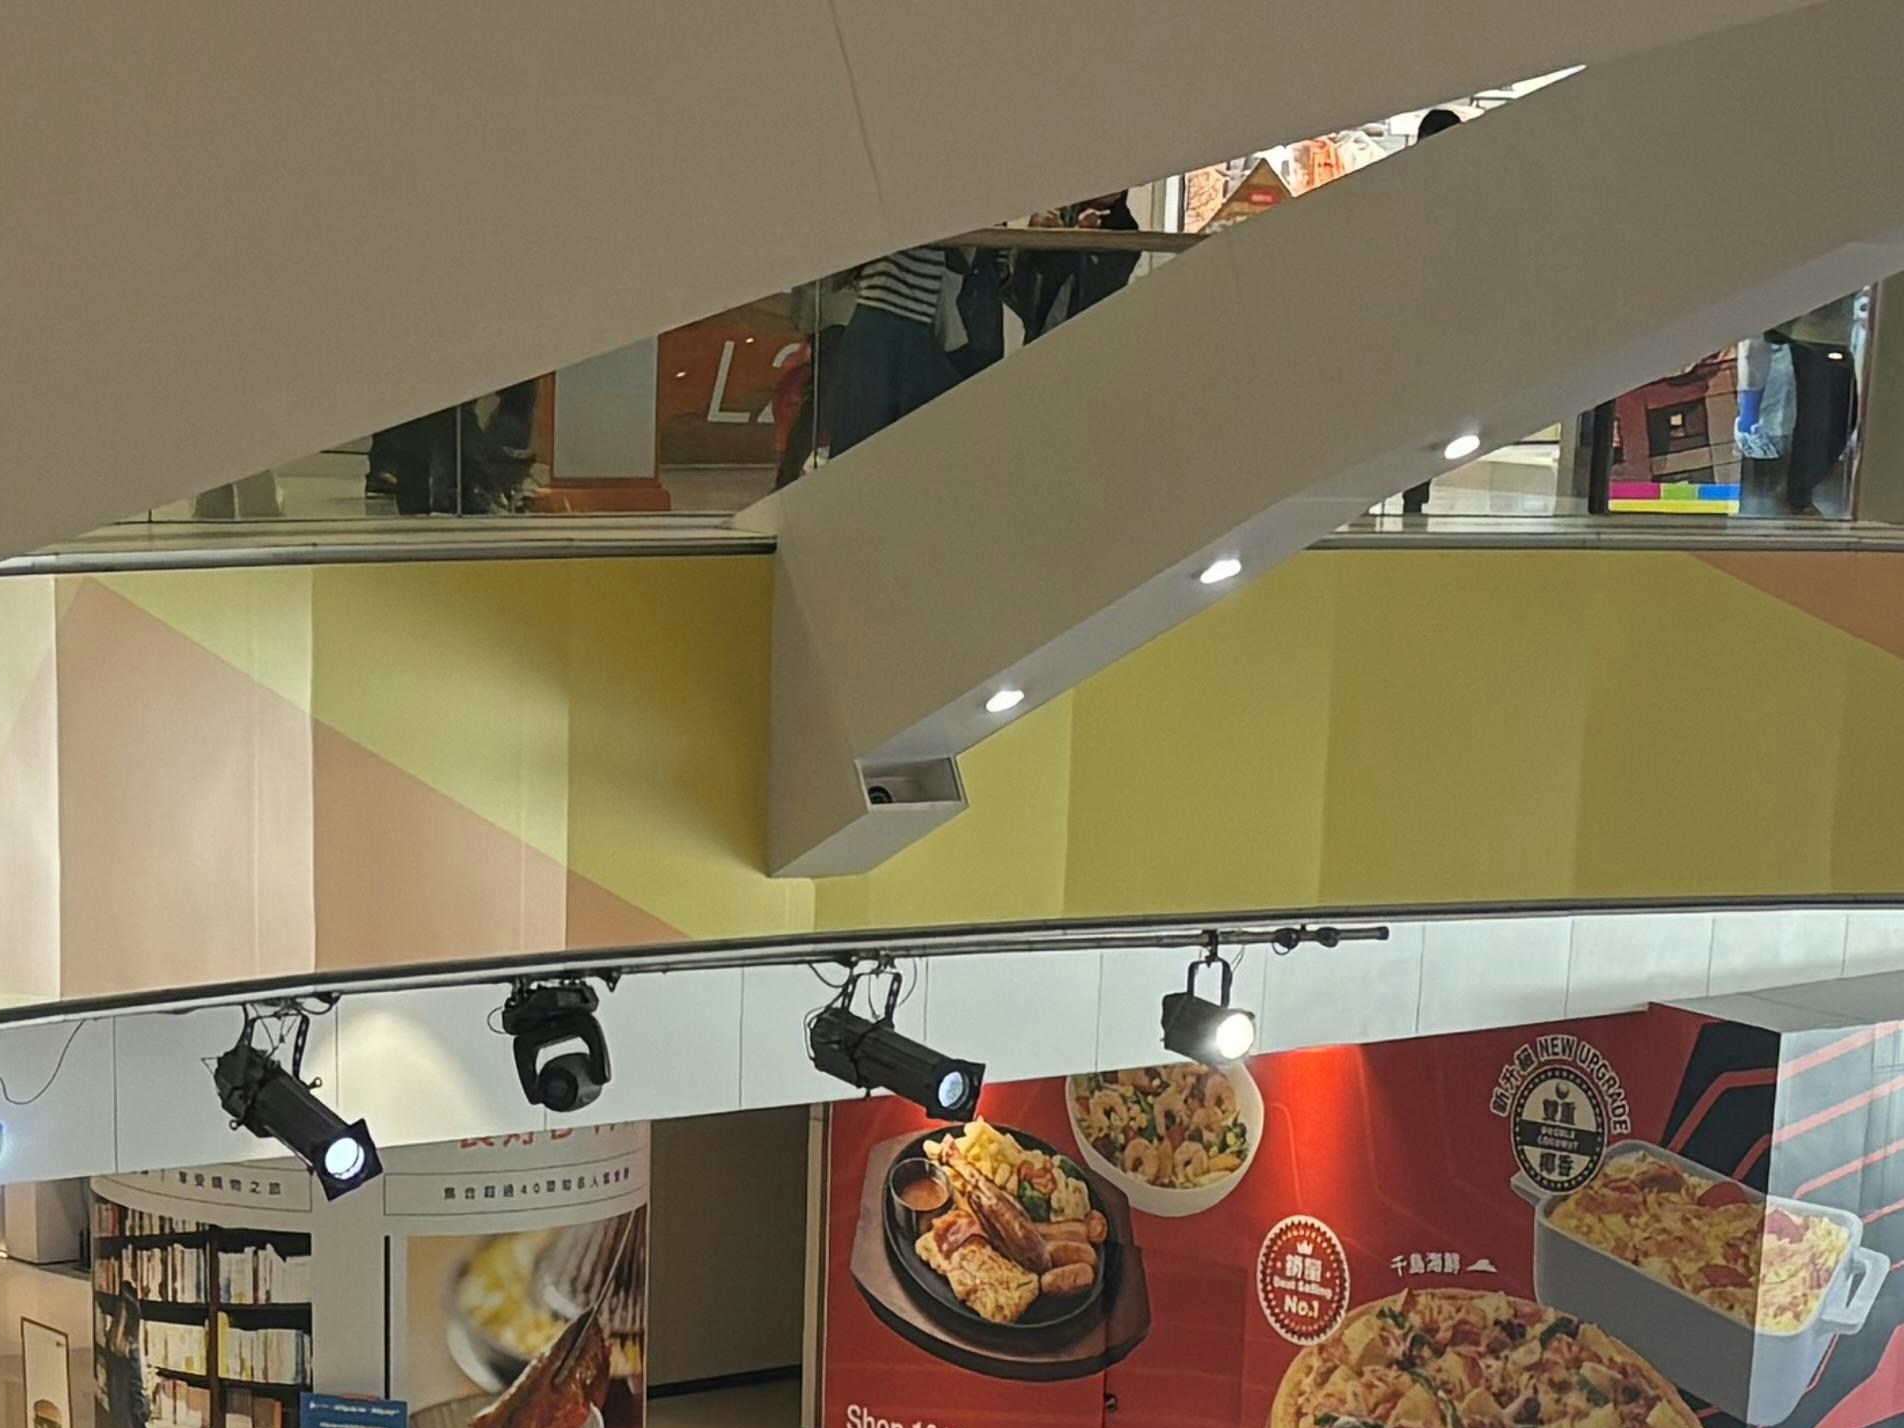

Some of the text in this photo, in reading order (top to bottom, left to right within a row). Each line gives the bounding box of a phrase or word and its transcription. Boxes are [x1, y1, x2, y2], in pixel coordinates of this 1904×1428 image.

[1536, 1035, 1630, 1134] NEW UPGRADE
[1284, 1294, 1320, 1319] No.1
